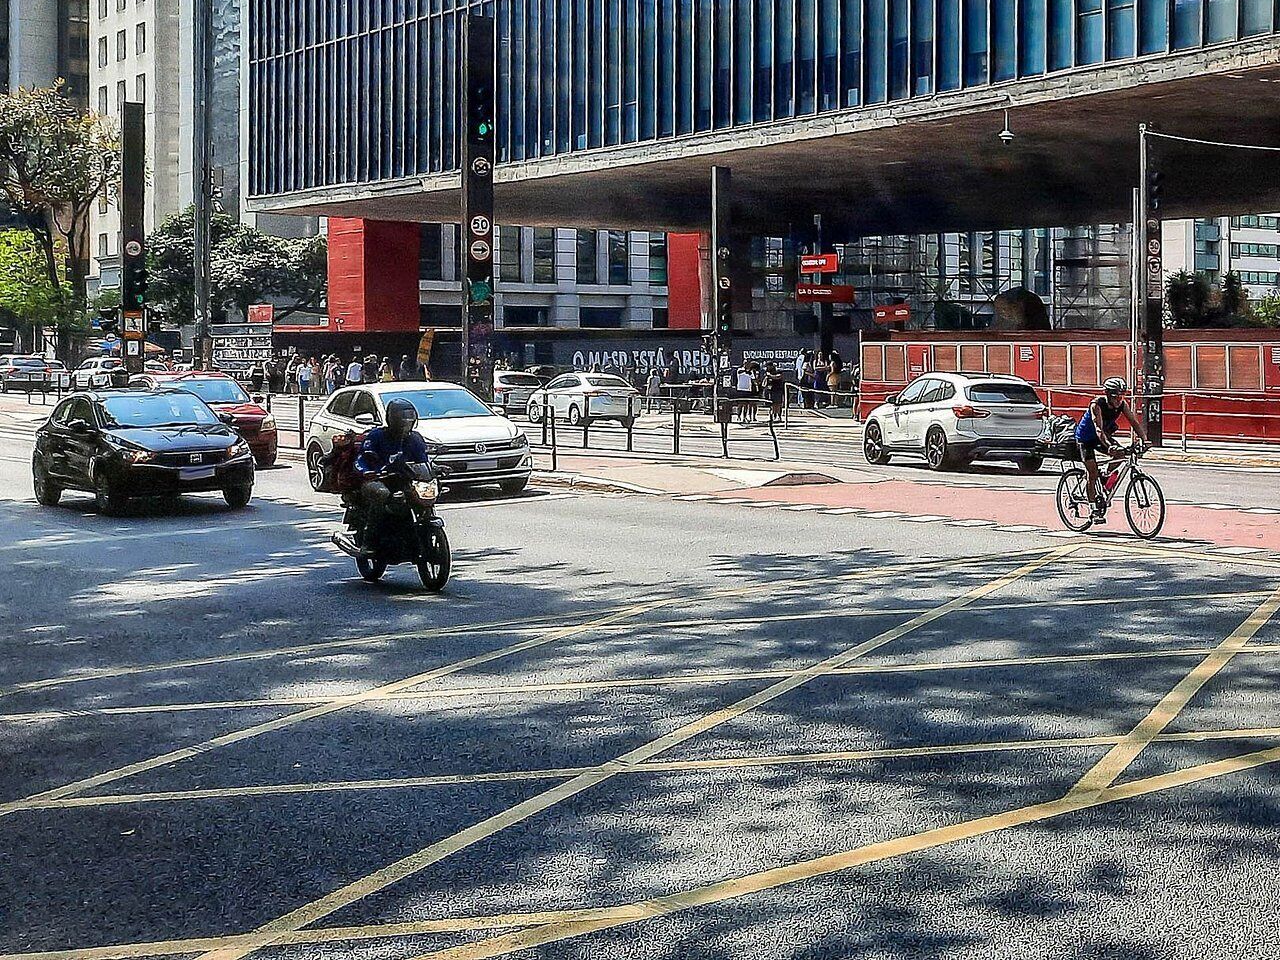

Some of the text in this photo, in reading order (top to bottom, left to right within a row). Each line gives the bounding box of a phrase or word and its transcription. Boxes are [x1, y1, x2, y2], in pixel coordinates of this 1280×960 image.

[472, 219, 488, 229] 50
[1149, 240, 1159, 249] 50
[673, 350, 712, 374] ABER
